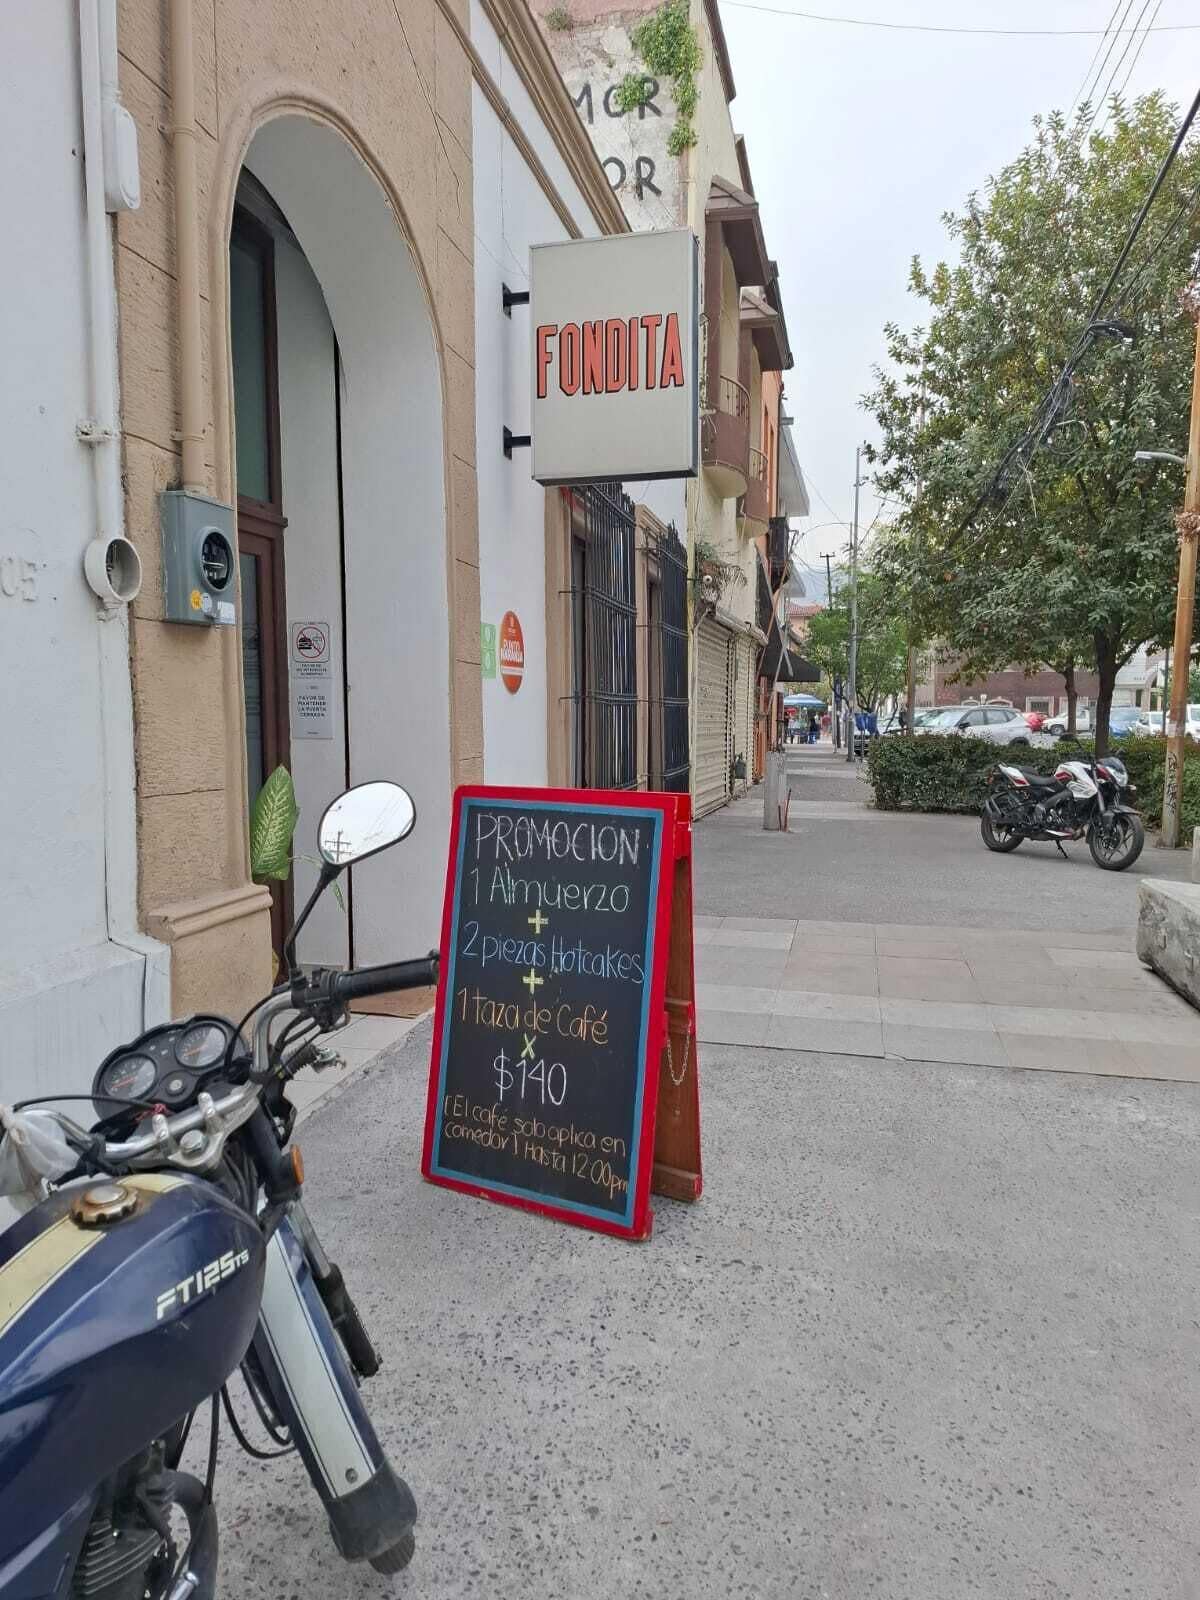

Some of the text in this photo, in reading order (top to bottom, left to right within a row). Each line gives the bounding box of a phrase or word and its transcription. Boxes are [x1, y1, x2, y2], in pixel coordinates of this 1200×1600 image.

[536, 312, 685, 399] FONDITA
[470, 861, 630, 913] 1 Almuerzo
[462, 921, 646, 985] 2 piezas Hotcakes
[457, 987, 609, 1045] 1 taza de Café
[493, 1047, 568, 1106] $140
[600, 1136, 626, 1158] en
